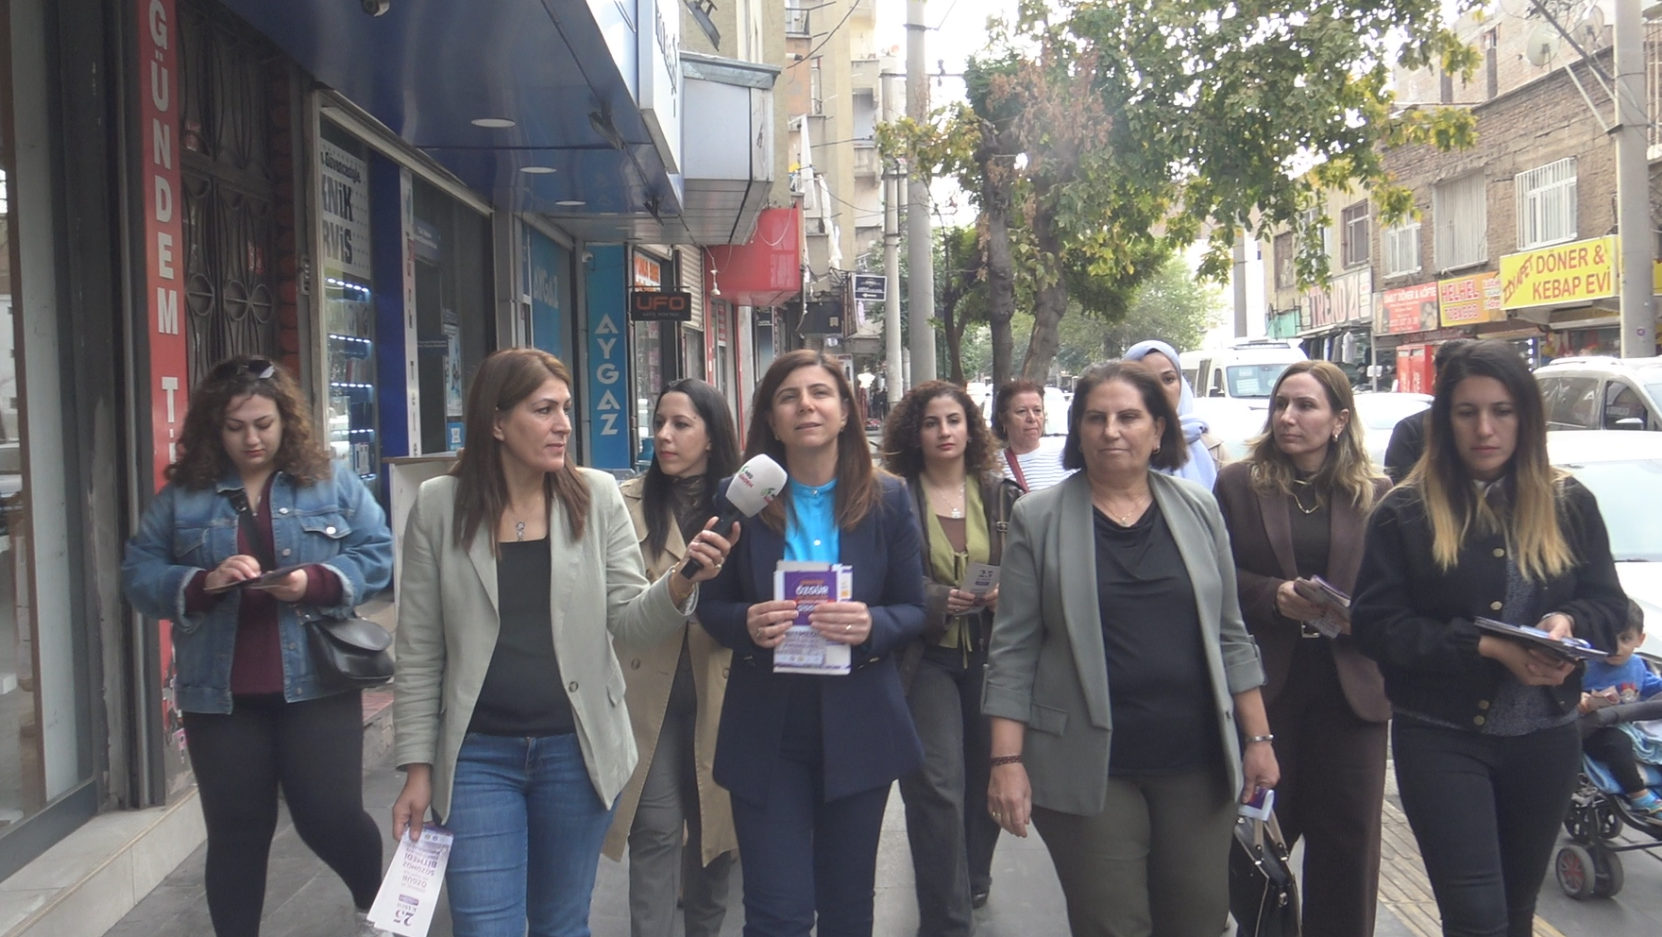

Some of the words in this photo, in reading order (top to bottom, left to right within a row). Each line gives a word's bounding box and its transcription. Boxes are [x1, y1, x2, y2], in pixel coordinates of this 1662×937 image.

[149, 0, 179, 335] GÜNDEM
[1536, 247, 1588, 274] DÖNER
[1593, 244, 1605, 265] &
[1532, 276, 1581, 301] KEBAP
[1586, 266, 1611, 294] EVİ
[636, 296, 685, 311] UFO
[594, 313, 621, 436] AYGAZ
[393, 909, 415, 927] 25
